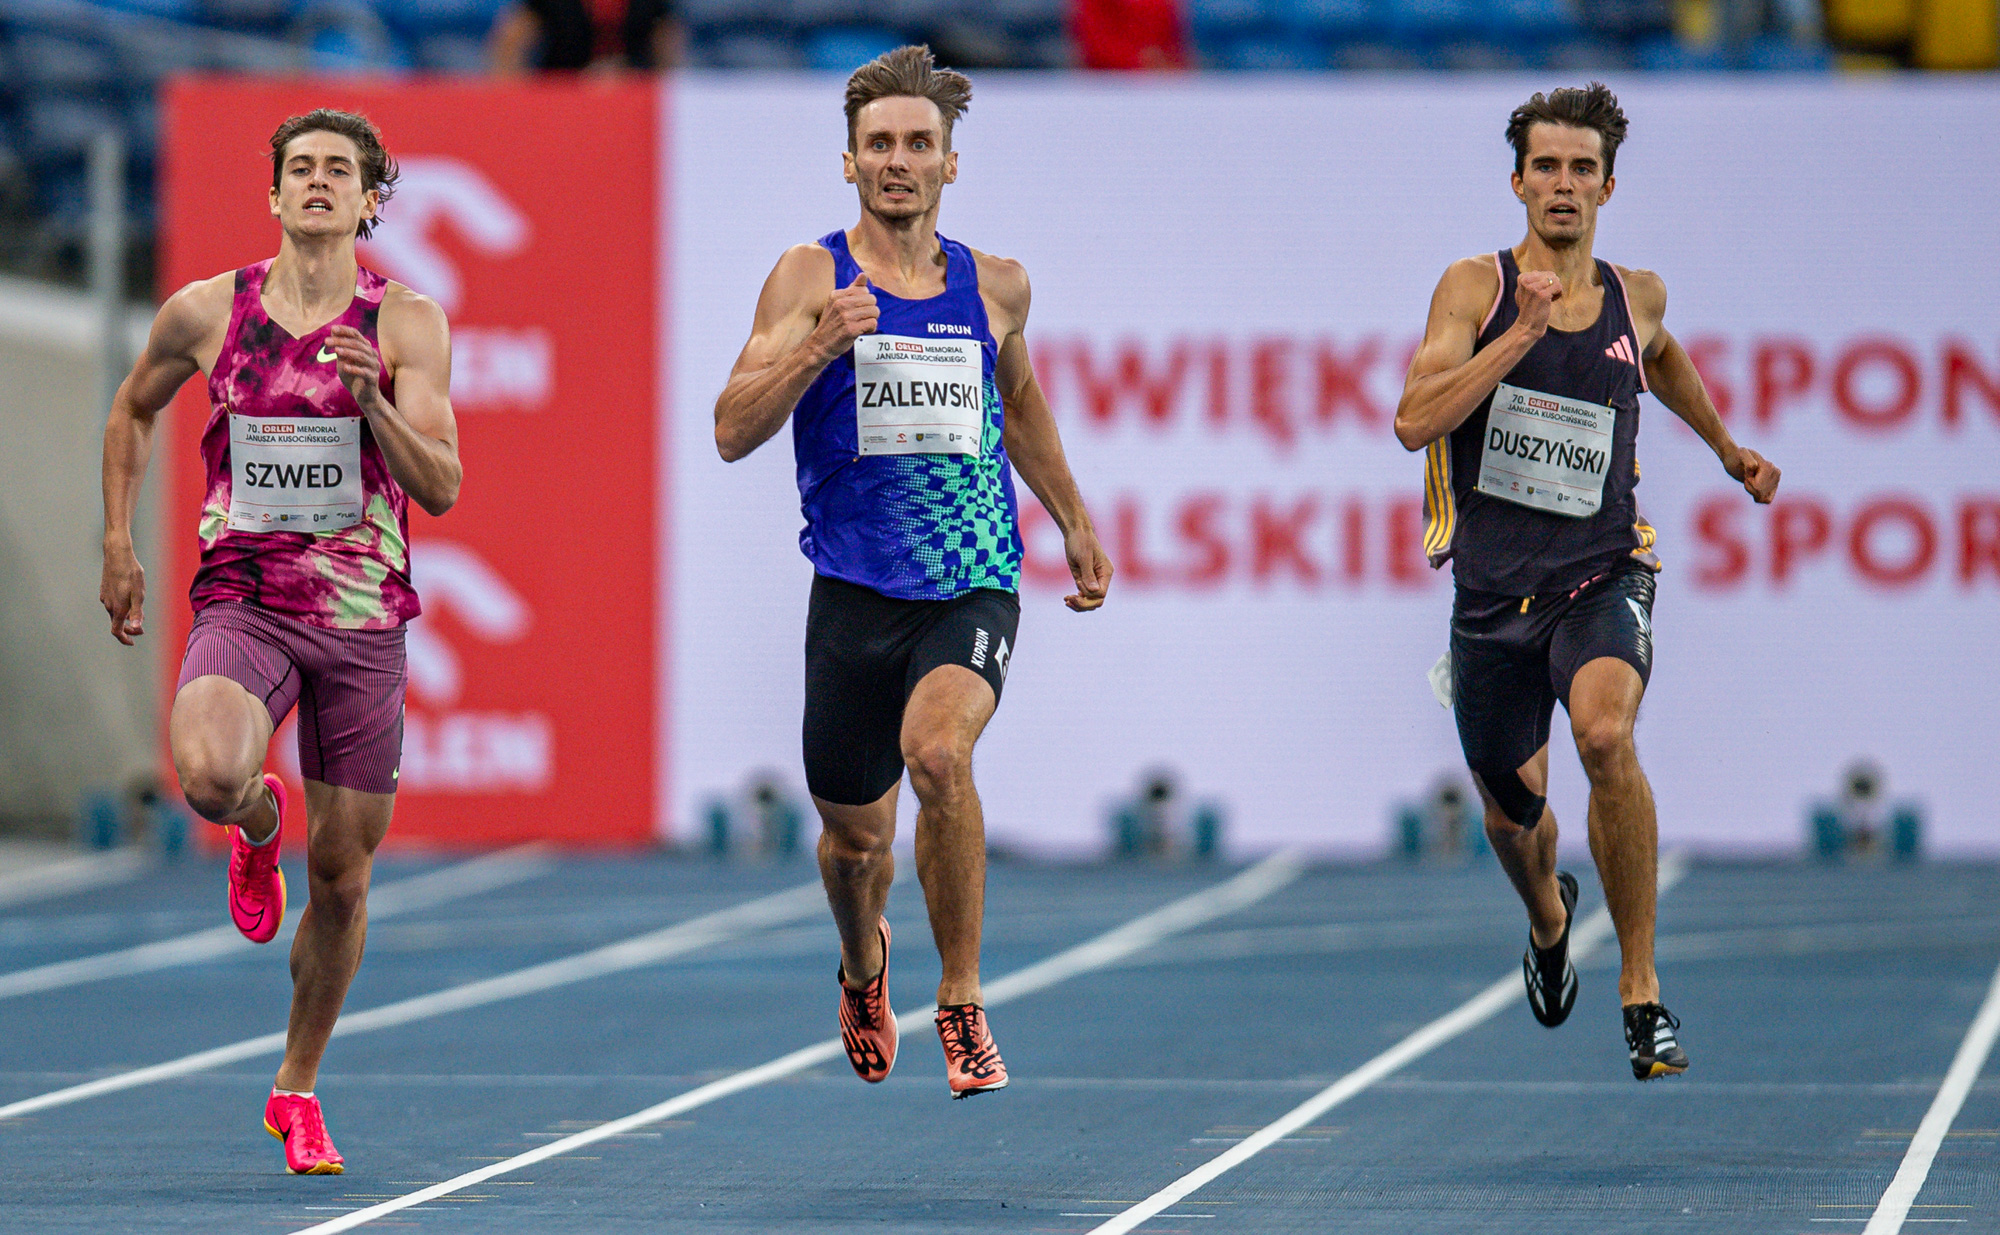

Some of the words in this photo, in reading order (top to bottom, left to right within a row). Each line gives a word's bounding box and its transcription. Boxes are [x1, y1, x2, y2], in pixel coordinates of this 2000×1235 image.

[927, 322, 972, 335] KIPRUN
[878, 342, 894, 351] 70.
[896, 343, 922, 352] ORLEN
[911, 354, 967, 363] KUSOCIŃSKIEGO
[861, 381, 979, 410] ZALEWSKI
[1512, 394, 1526, 405] 70.
[1529, 398, 1559, 411] ORLEN
[1560, 405, 1597, 419] MEMORIAŁ
[1507, 404, 1540, 417] JANUSZA
[1541, 411, 1598, 428] KUSOCIŃSKIEGO
[246, 434, 276, 442] JANUSZA
[278, 434, 340, 443] KUSOCIŃSKIEGO
[247, 424, 260, 433] 70.
[263, 425, 294, 433] ORLEN
[1489, 427, 1606, 474] DUSZYŃSKI
[245, 462, 343, 488] SZWED
[970, 627, 989, 669] KIPRUN
